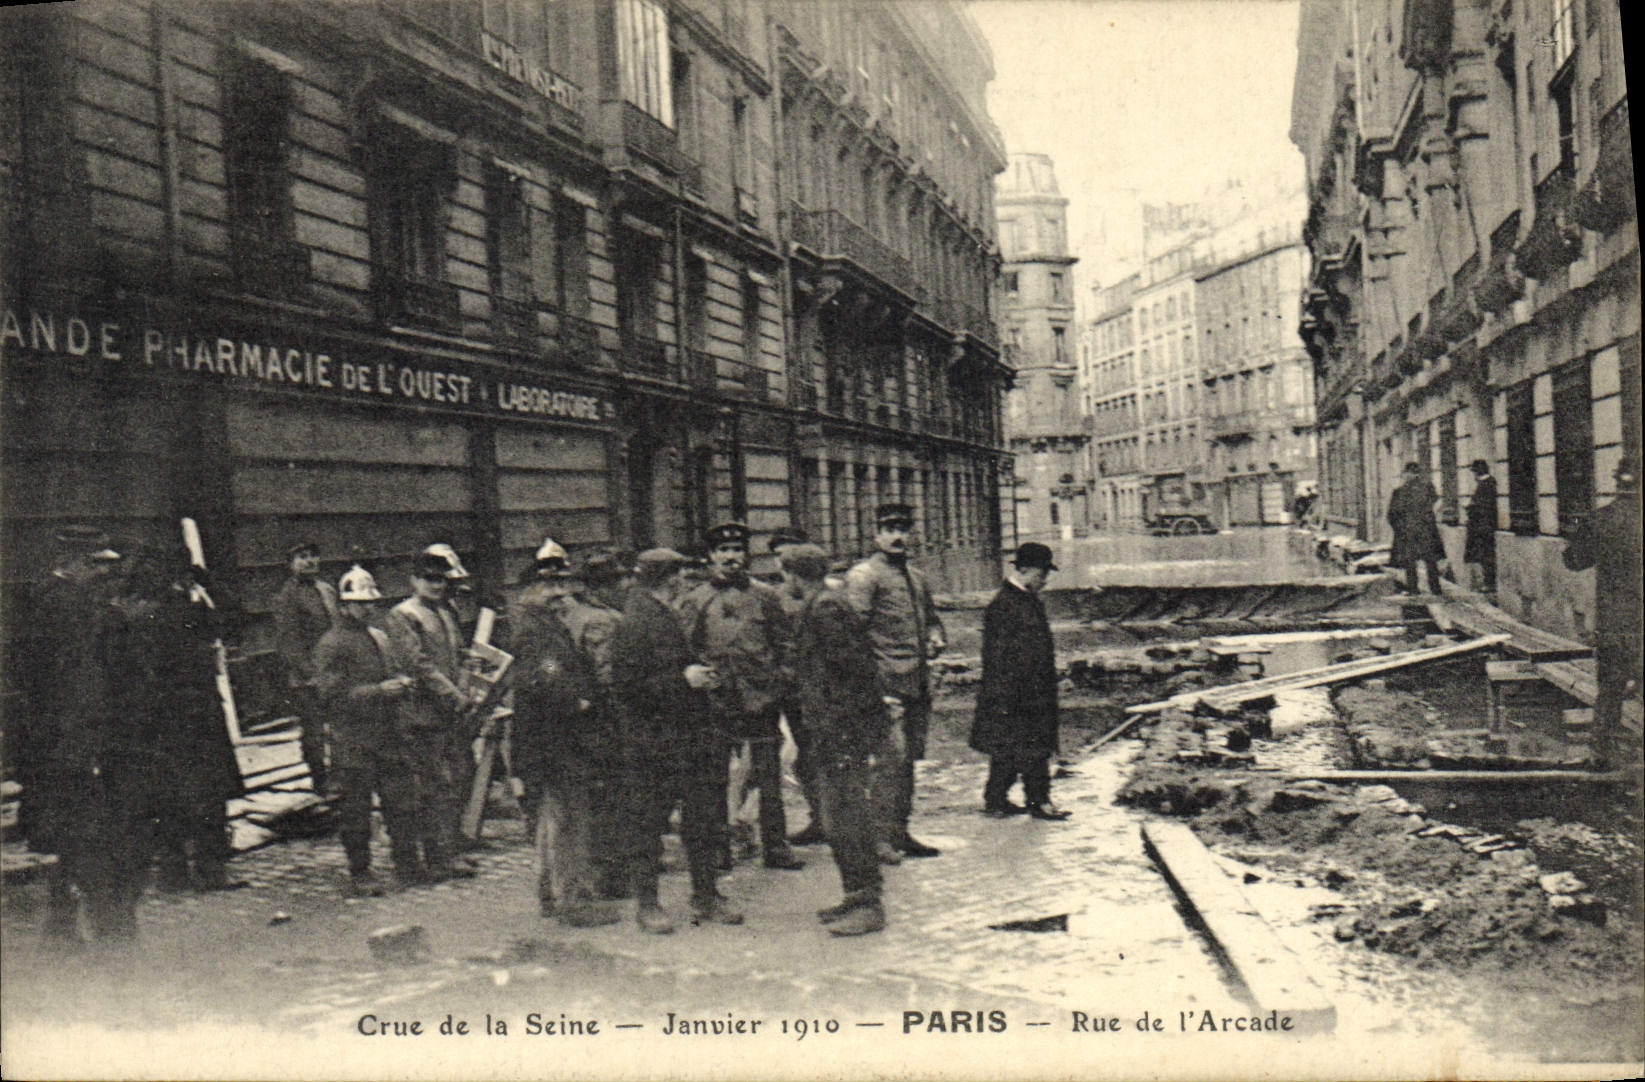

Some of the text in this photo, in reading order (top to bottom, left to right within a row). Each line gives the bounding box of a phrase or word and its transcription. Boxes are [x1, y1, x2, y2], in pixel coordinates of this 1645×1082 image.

[0, 308, 601, 421] ANDE PHARMACIE DE L'OUEST LABORATOIRE
